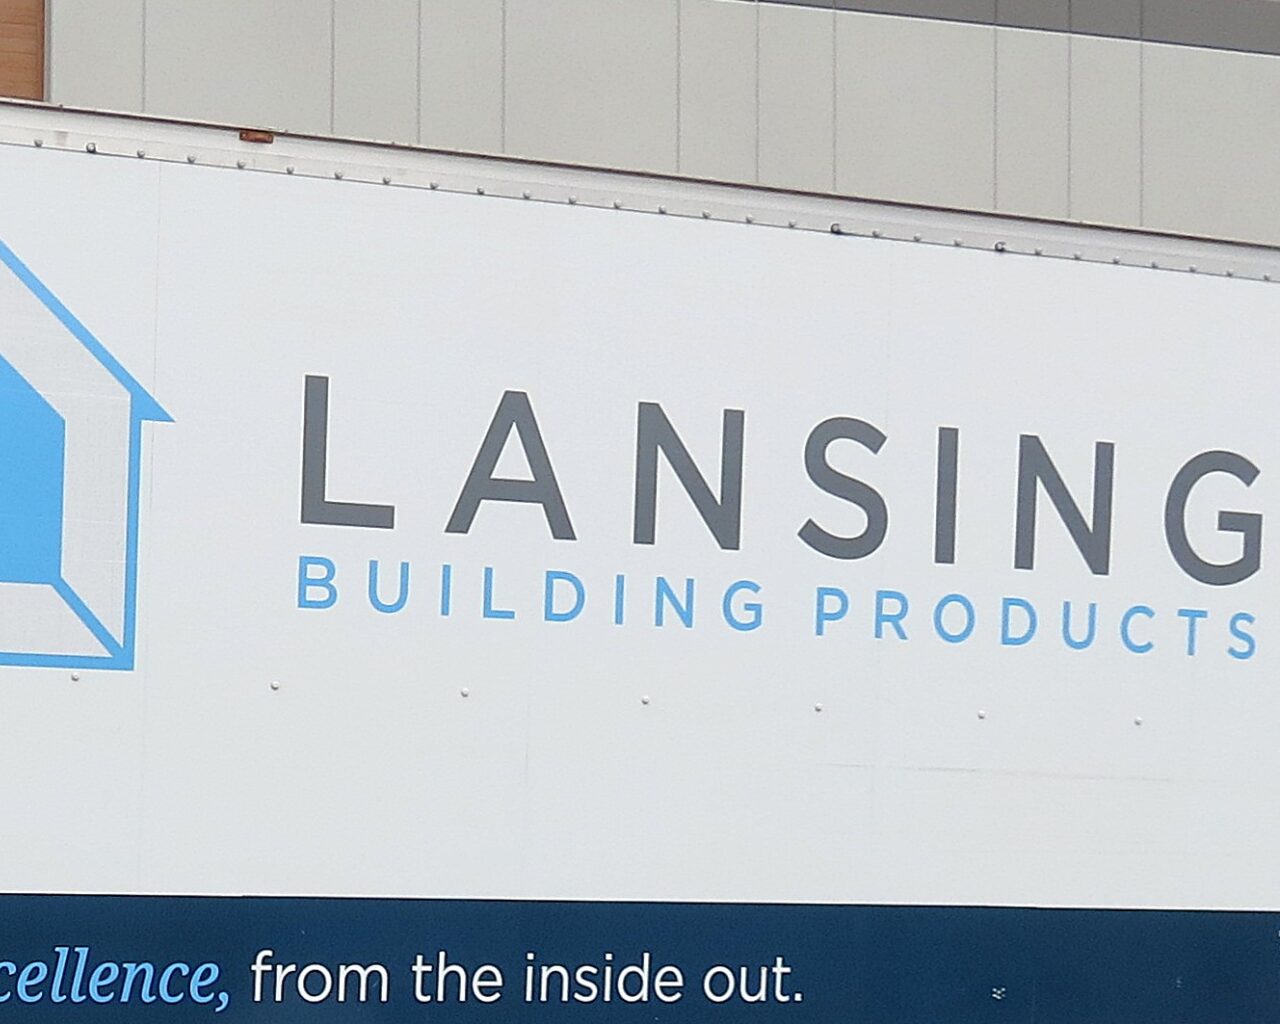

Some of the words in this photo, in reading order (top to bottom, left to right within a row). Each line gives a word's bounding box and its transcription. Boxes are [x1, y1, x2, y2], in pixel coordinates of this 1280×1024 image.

[300, 374, 1263, 587] LANSING
[297, 556, 764, 631] BUILDING
[814, 586, 1258, 661] PRODUCTS
[251, 950, 389, 1003] from
[411, 951, 503, 1003] the
[524, 952, 684, 1003] inside
[703, 956, 803, 1003] out.
